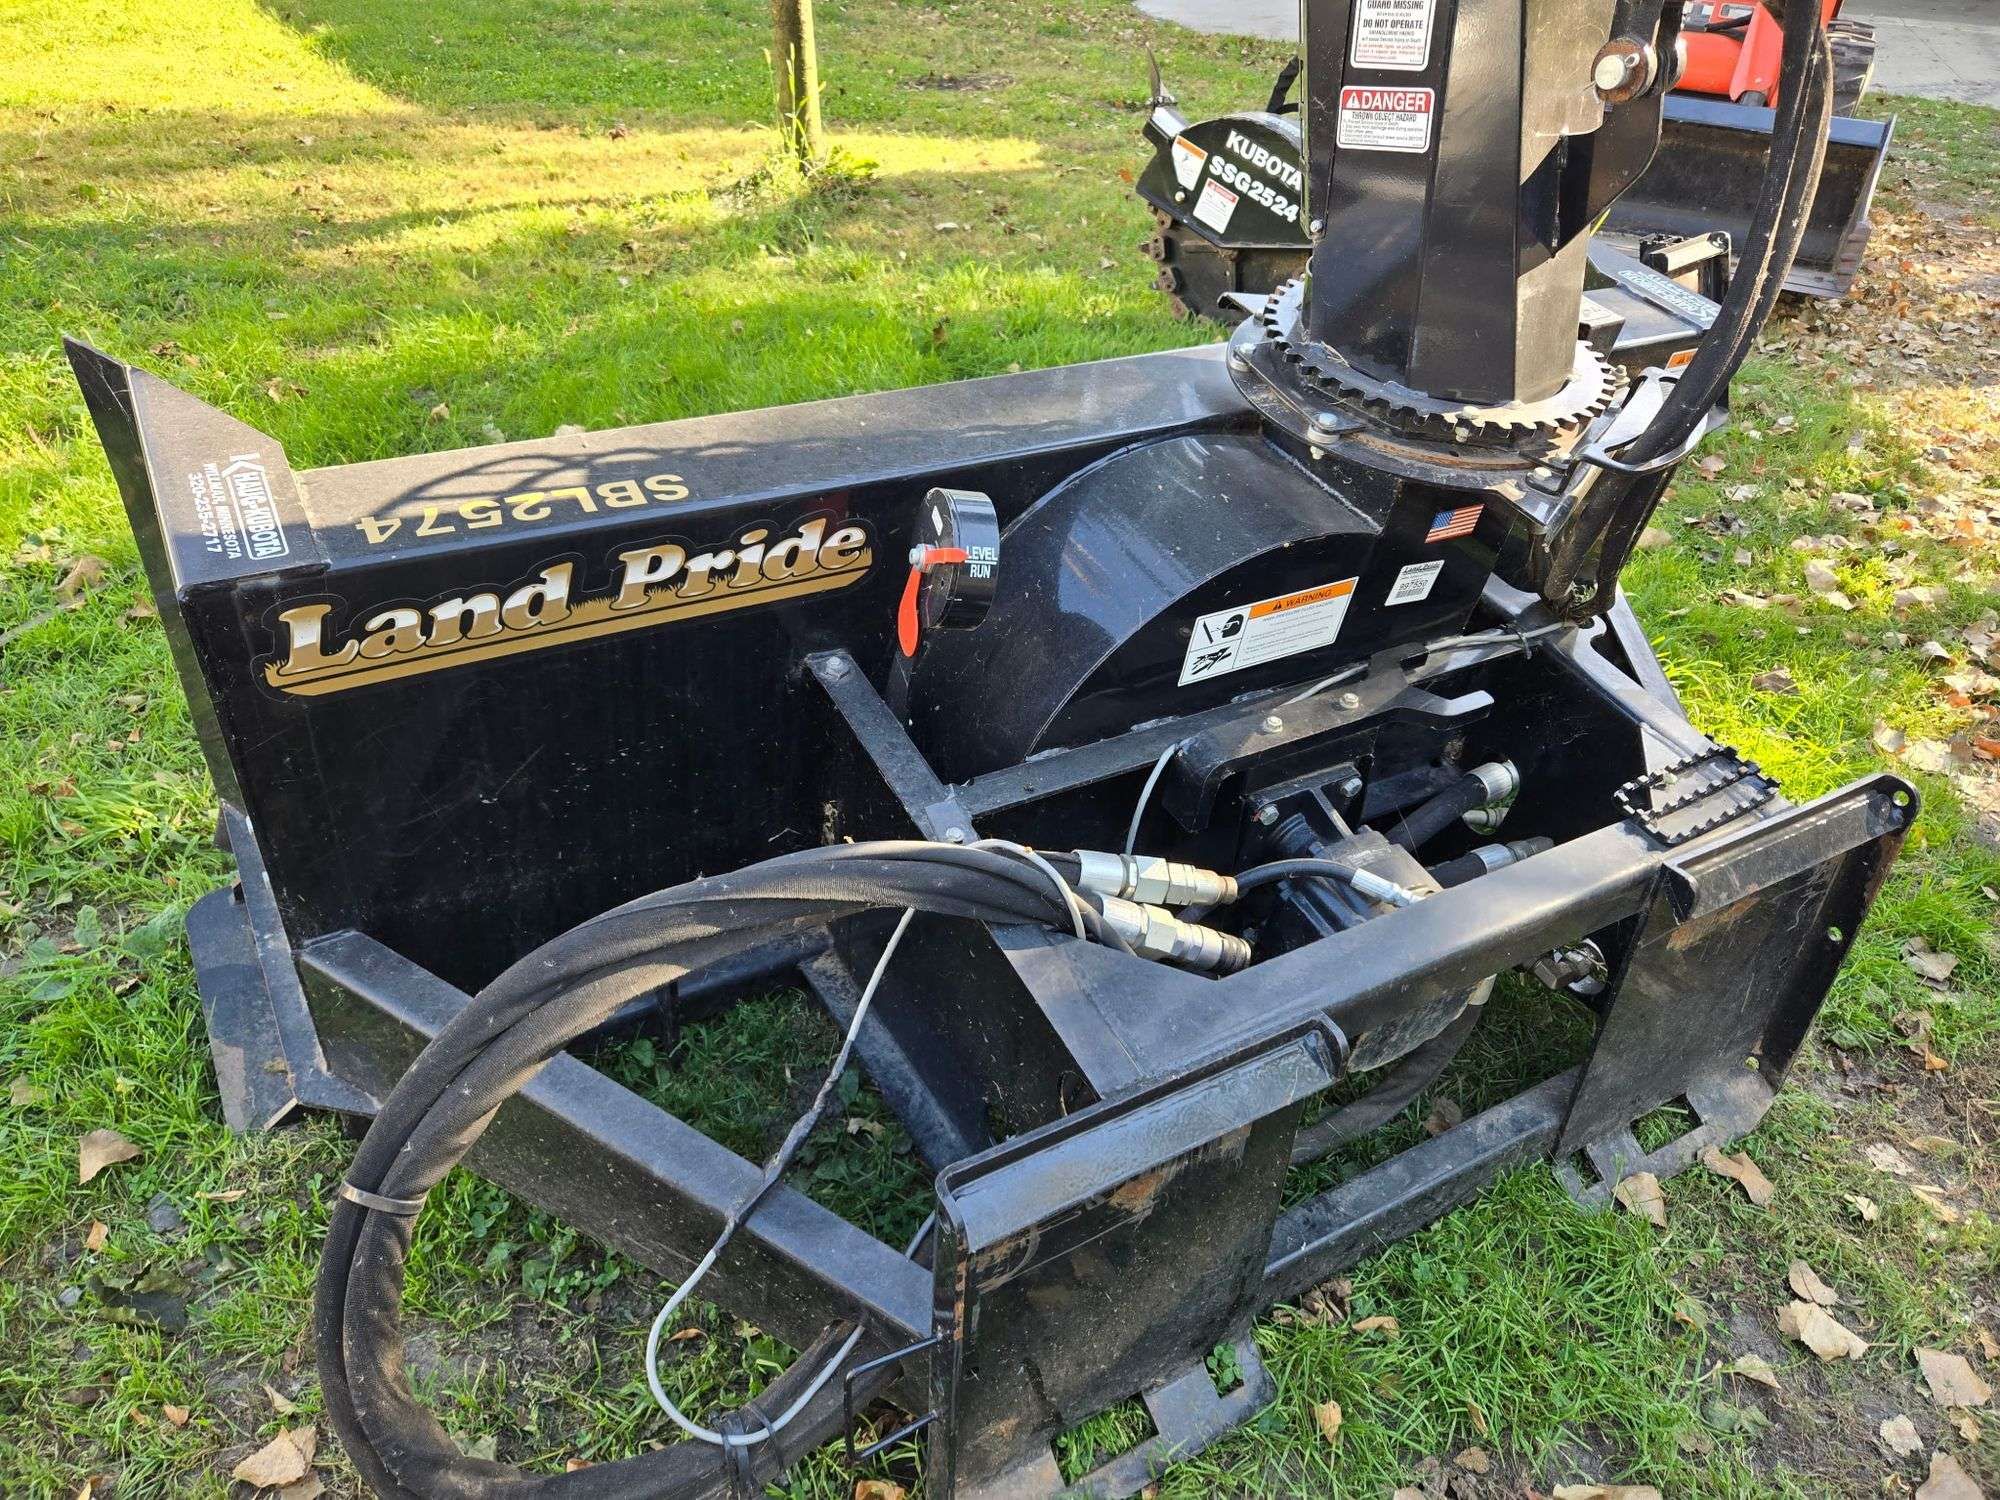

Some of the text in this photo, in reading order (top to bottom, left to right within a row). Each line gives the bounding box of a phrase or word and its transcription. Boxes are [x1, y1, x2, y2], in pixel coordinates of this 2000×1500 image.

[1367, 0, 1424, 10] GUARD MISSING
[1363, 19, 1424, 29] DO NOT OPERATE
[1352, 111, 1417, 122] THROWN OBJECT HAZARD
[1361, 92, 1425, 111] DANGER
[1225, 129, 1302, 191] KUBOTA
[1209, 155, 1300, 223] SSG2524
[188, 472, 223, 553] 320-235-2717
[232, 471, 282, 557] HAUG-KUBOTA
[355, 474, 690, 544] SBL2574
[215, 505, 242, 559] MINNESOTA
[966, 546, 998, 561] LEVEL
[970, 564, 991, 578] RUN
[278, 517, 866, 674] Land Pride
[1286, 589, 1332, 608] WARNING
